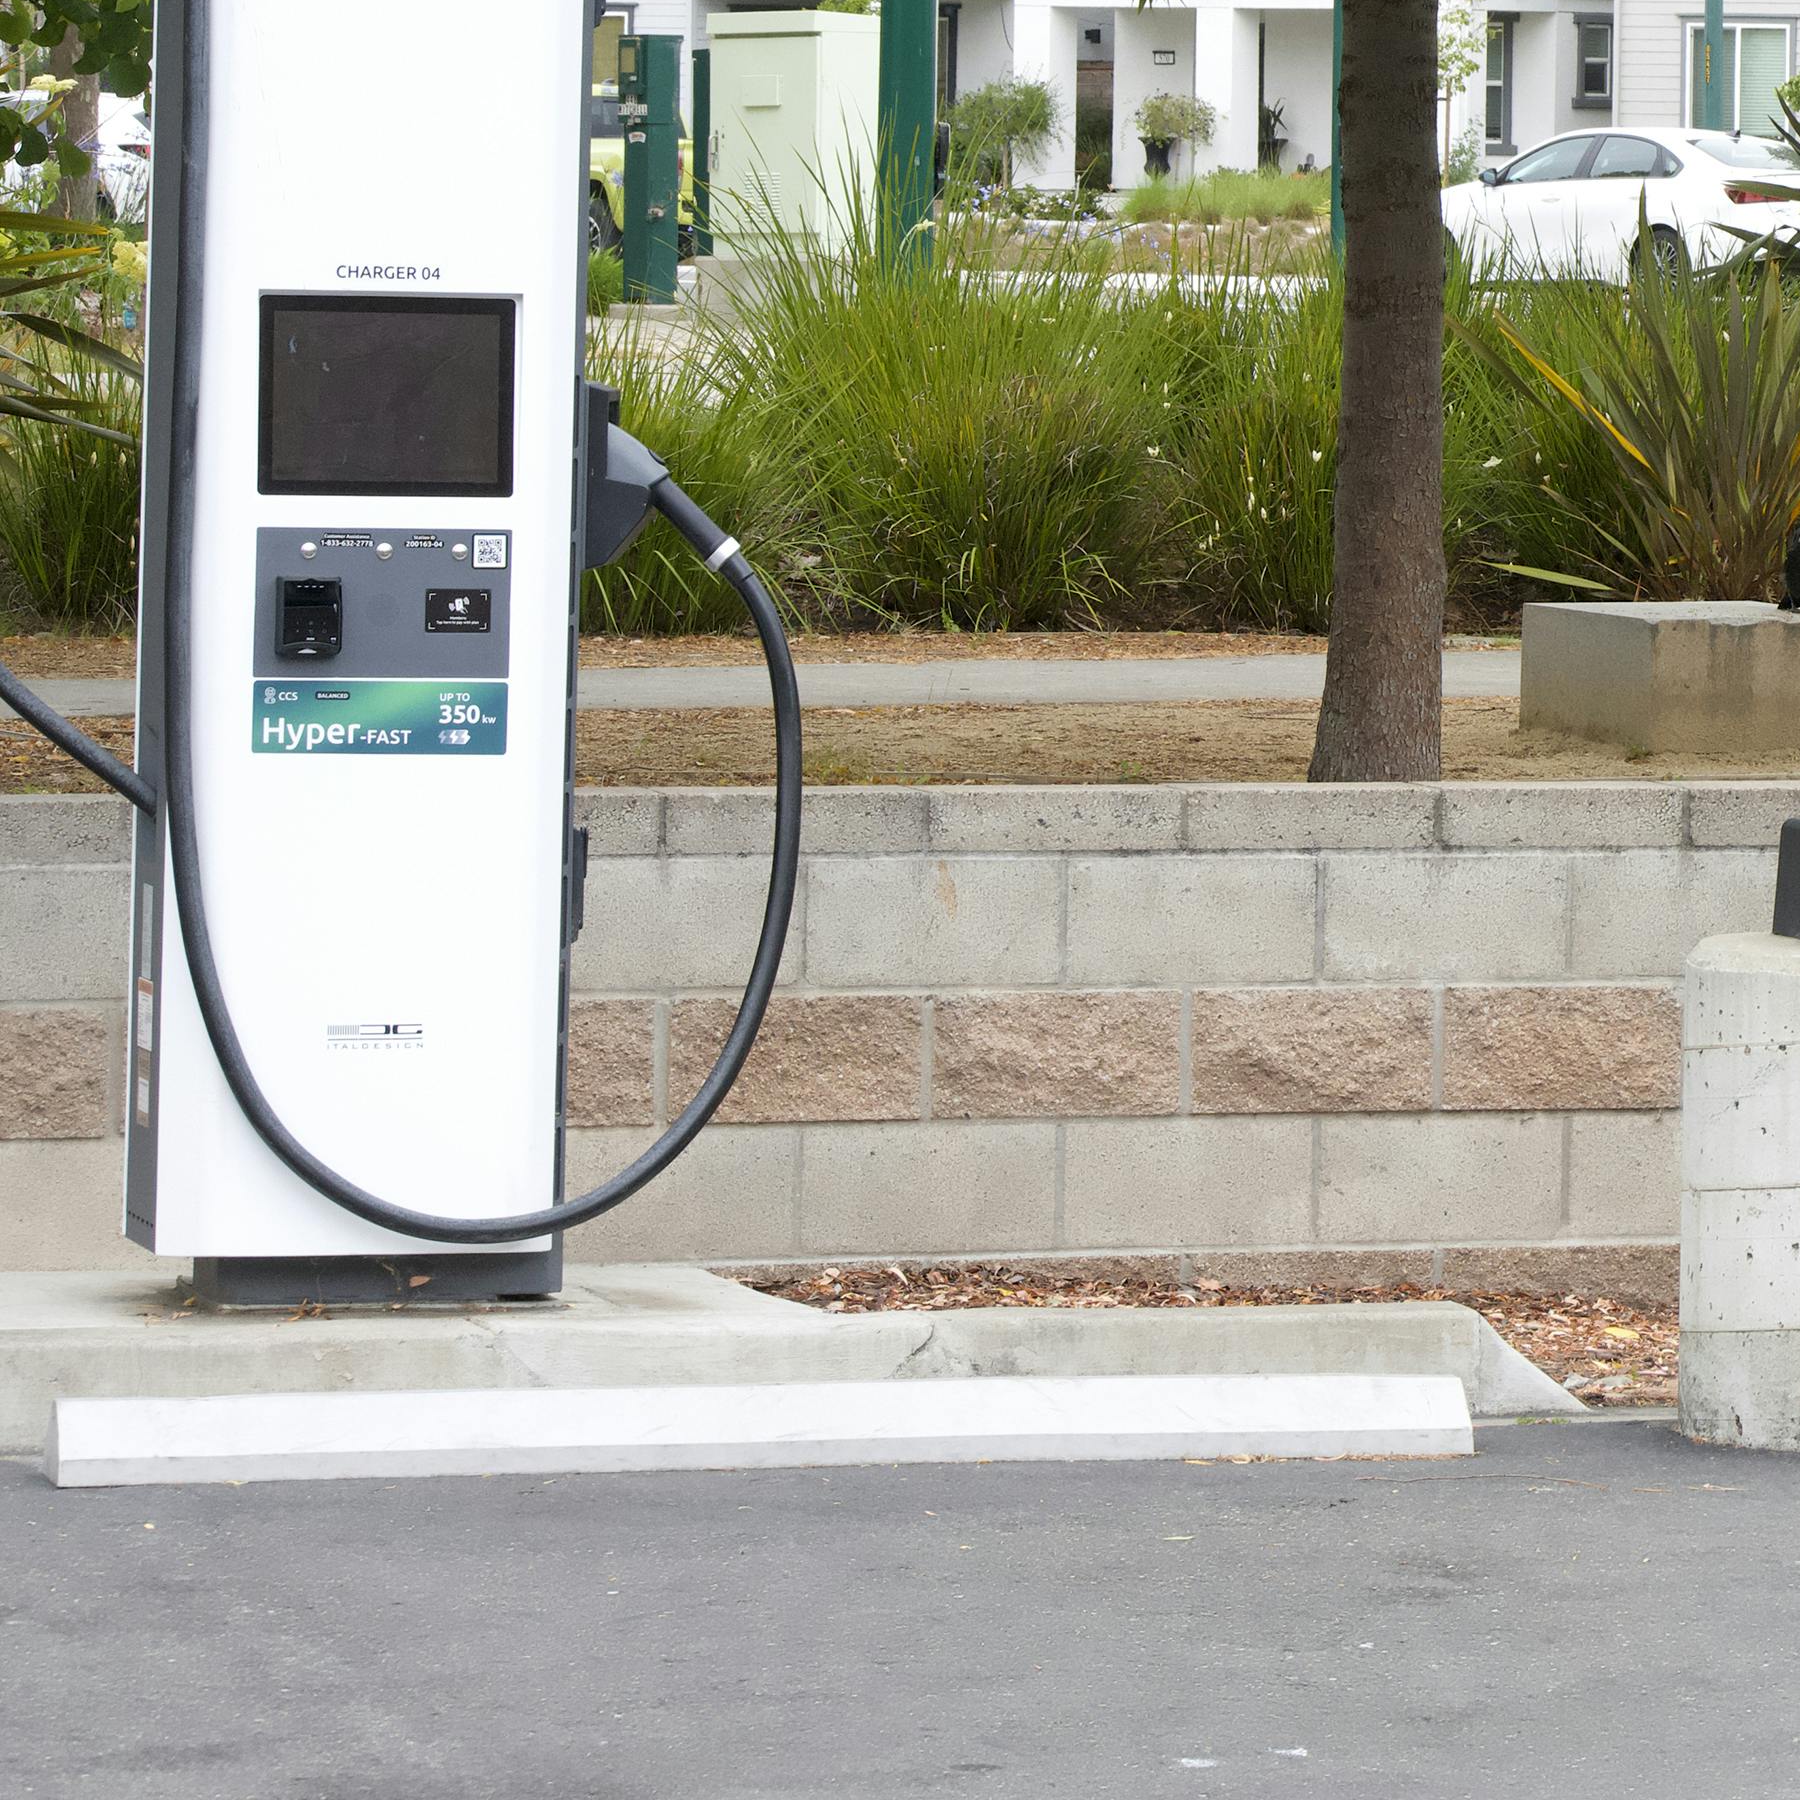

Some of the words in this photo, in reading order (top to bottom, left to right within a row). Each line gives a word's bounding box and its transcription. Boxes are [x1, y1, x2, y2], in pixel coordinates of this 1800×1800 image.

[336, 264, 417, 280] CHARGER
[422, 265, 441, 280] 04
[278, 691, 299, 701] CCS
[317, 692, 349, 700] BALANCED
[439, 693, 454, 702] UP
[456, 693, 471, 702] TO
[438, 705, 481, 725] 350
[262, 717, 412, 751] Hyper-FAST
[327, 1042, 424, 1050] ITALDESIGN
